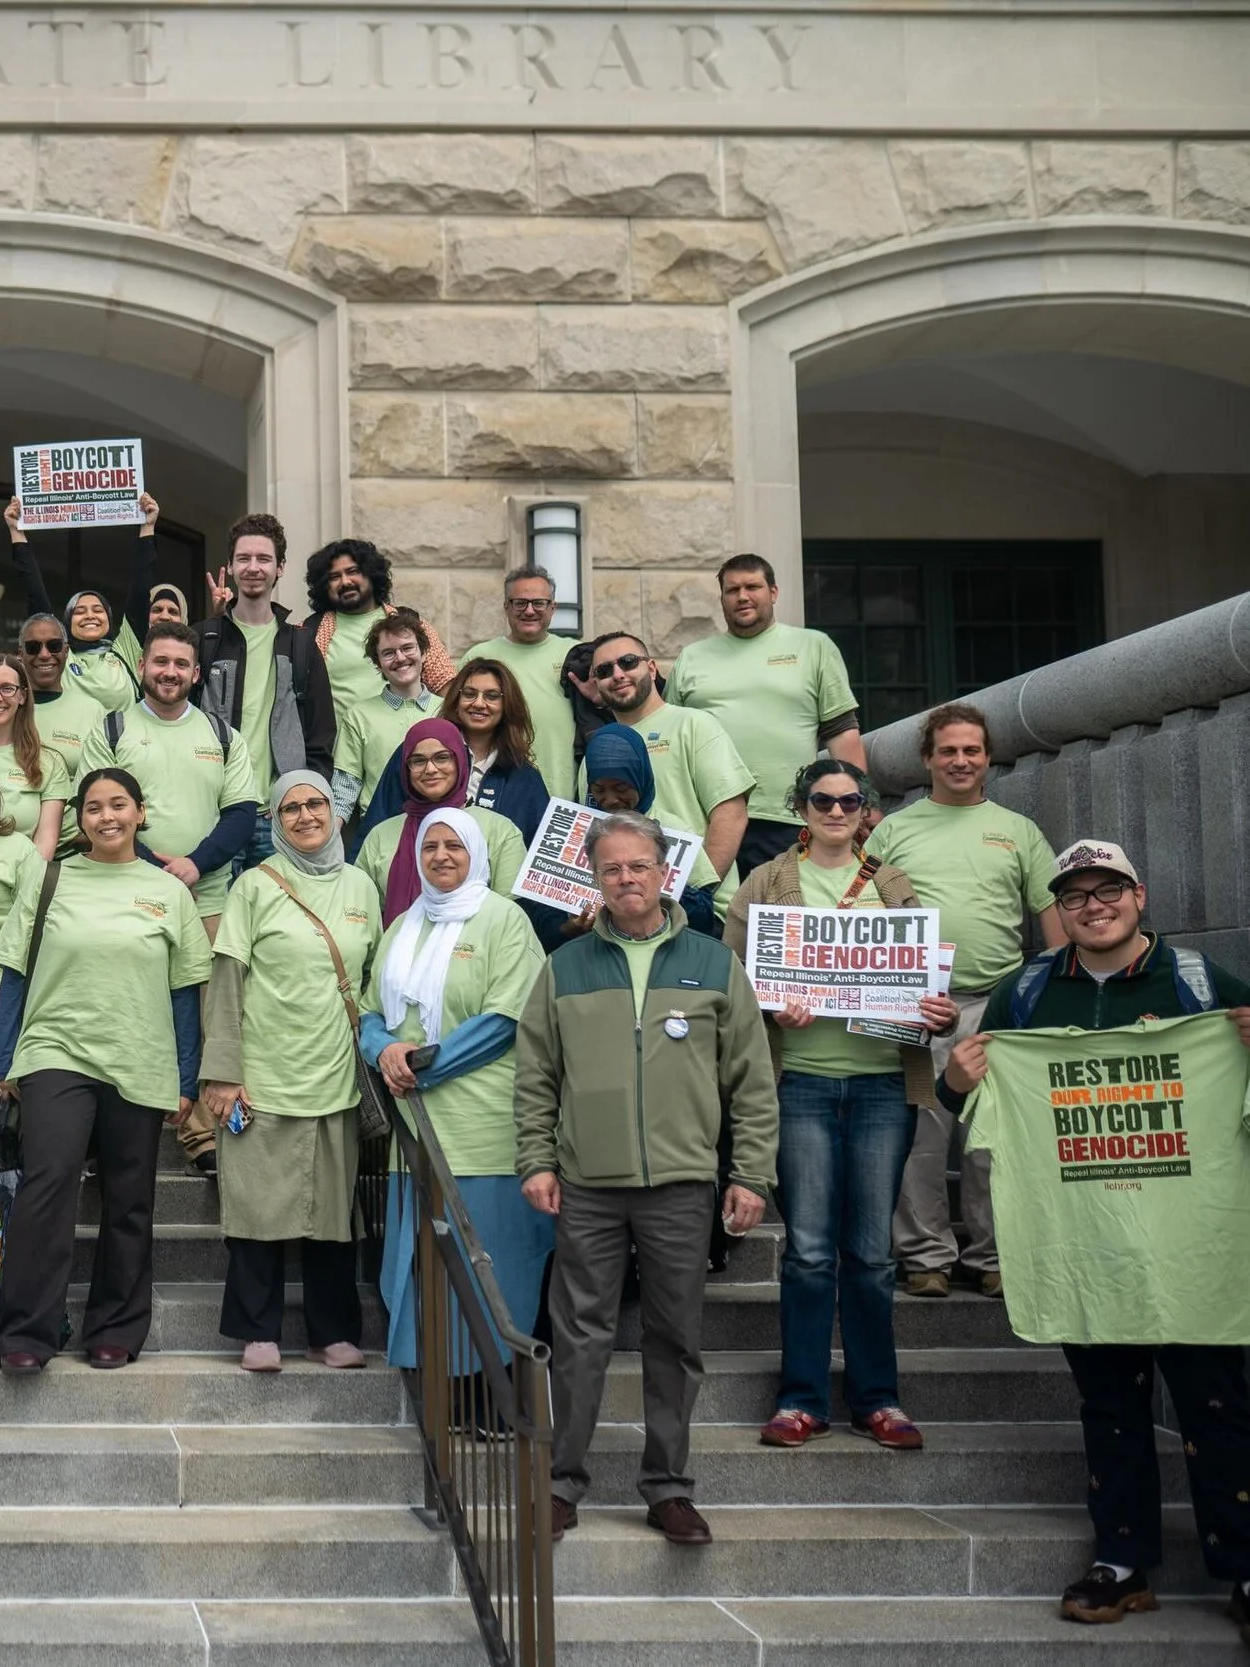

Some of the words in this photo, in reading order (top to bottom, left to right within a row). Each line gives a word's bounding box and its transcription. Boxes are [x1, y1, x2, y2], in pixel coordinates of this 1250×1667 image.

[277, 21, 814, 92] LIBRARY
[51, 445, 134, 471] BOYCOTT
[20, 450, 40, 493] RESTORE
[53, 469, 137, 491] GENOCIDE
[24, 507, 34, 515] THE
[36, 506, 59, 514] ILLINOIS
[578, 812, 592, 822] TO
[537, 806, 578, 859] RESTORE
[567, 822, 588, 847] RIGHT
[535, 859, 564, 874] Repeal
[560, 846, 578, 864] OUR
[1059, 849, 1089, 871] White
[1091, 848, 1113, 860] Sox
[527, 870, 542, 882] THE
[542, 875, 571, 891] ILLINOIS
[522, 879, 545, 894] RIGHTS
[545, 887, 580, 906] ADVOCACY
[786, 913, 801, 921] TO
[756, 912, 784, 965] RESTORE
[785, 924, 801, 948] RIGHT
[803, 915, 928, 944] BOYCOTT
[785, 950, 800, 966] OUR
[802, 944, 928, 970] GENOCIDE
[760, 968, 793, 979] Repeal
[796, 972, 831, 982] Illinois'
[834, 975, 899, 984] Anti-Boycott
[902, 976, 923, 984] Law
[755, 981, 770, 991] THE
[774, 983, 808, 995] ILLINOIS
[810, 986, 837, 997] HUMAN
[865, 994, 900, 1003] Coalition
[825, 998, 836, 1009] ACT
[895, 1004, 920, 1013] Rights
[1048, 1053, 1181, 1088] RESTORE
[1051, 1088, 1092, 1106] OUR
[1097, 1084, 1155, 1103] RIGHT
[1162, 1082, 1183, 1099] TO
[1054, 1100, 1183, 1136] BOYCOTT
[1058, 1132, 1190, 1163] GENOCIDE
[1064, 1168, 1088, 1178] Repeal
[1119, 1166, 1169, 1176] Anti-Boycott
